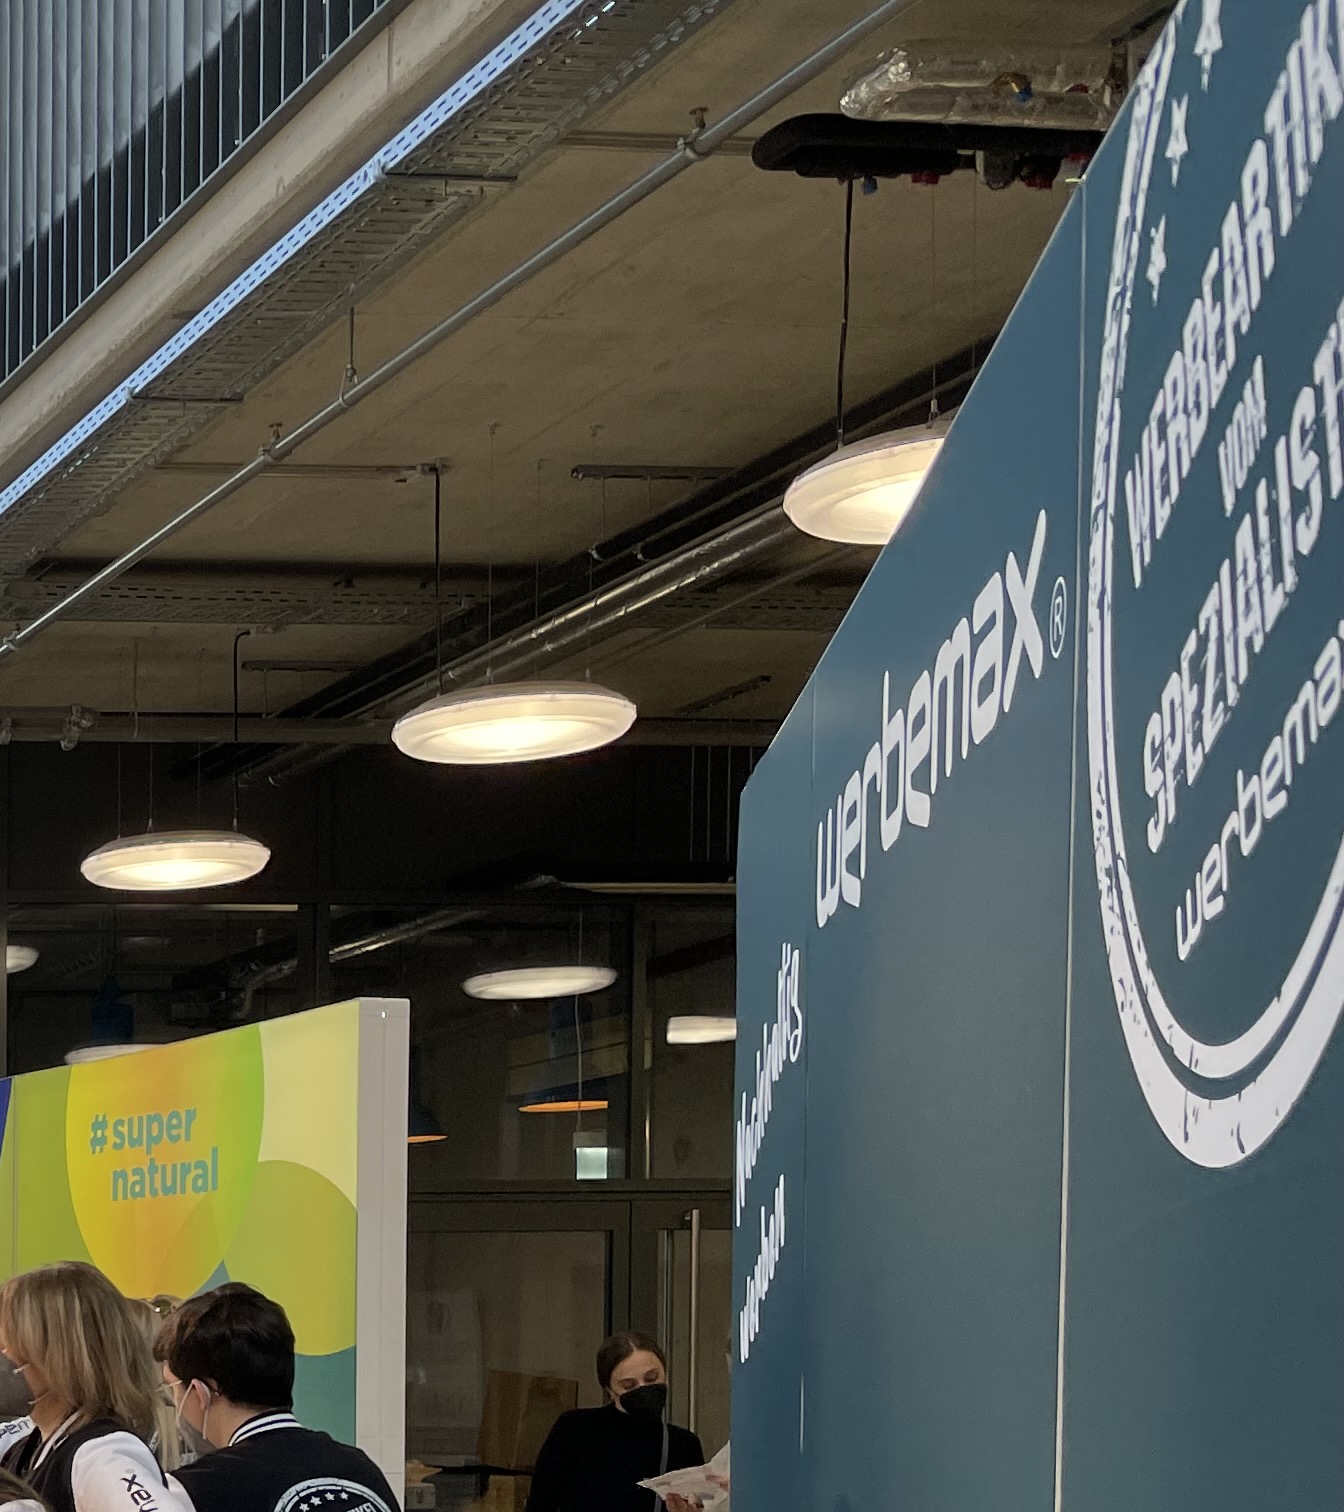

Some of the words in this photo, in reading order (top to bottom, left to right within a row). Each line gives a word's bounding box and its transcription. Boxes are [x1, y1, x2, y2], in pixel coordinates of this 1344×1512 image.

[1124, 0, 1344, 590] WERBEARTIK
[1144, 293, 1344, 854] SPEZIALIST
[90, 1108, 197, 1156] #super
[112, 1146, 218, 1201] natural
[736, 942, 802, 1228] Nachhaltig
